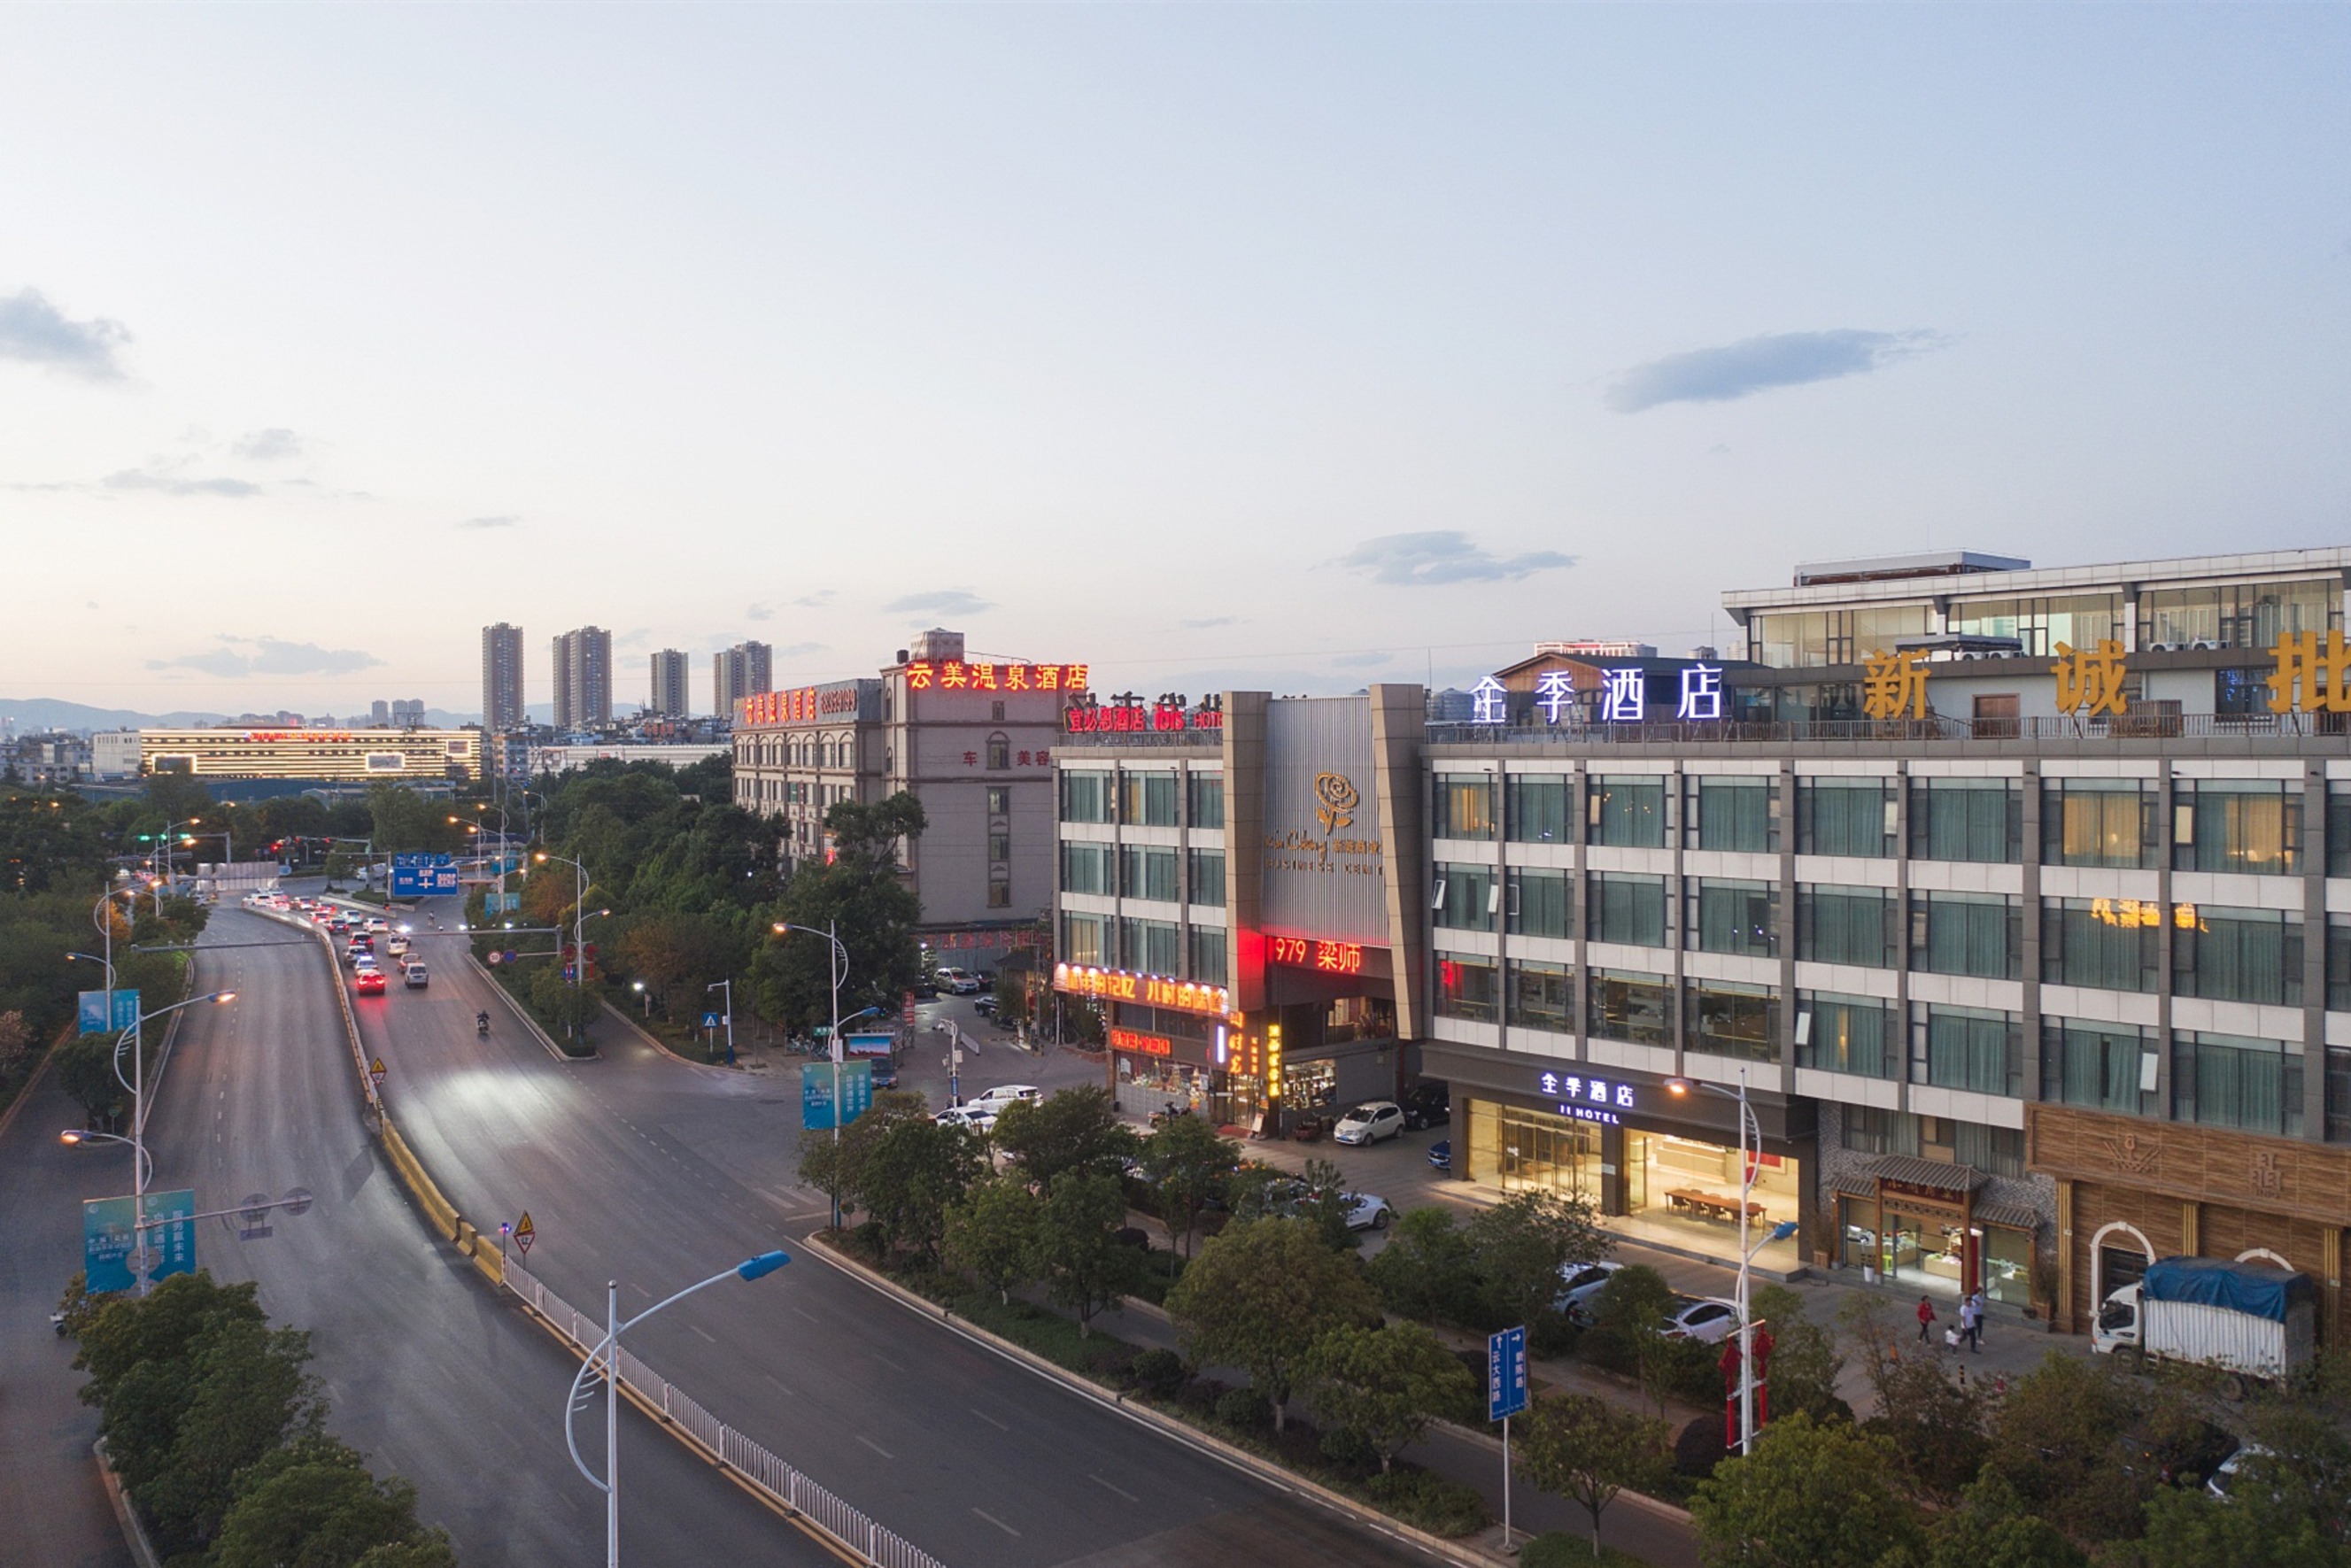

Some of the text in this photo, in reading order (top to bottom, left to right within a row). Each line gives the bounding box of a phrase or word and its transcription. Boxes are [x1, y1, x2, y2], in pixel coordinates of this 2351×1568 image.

[907, 662, 1088, 690] 云美温泉酒店
[1470, 663, 1723, 723] 全季酒店
[1069, 707, 1145, 732] 宜必思酒店
[1154, 704, 1185, 731] ibis
[1276, 938, 1361, 974] 979 梁师
[1542, 1072, 1634, 1108] 全季酒店
[1575, 1108, 1620, 1124] HOTEL
